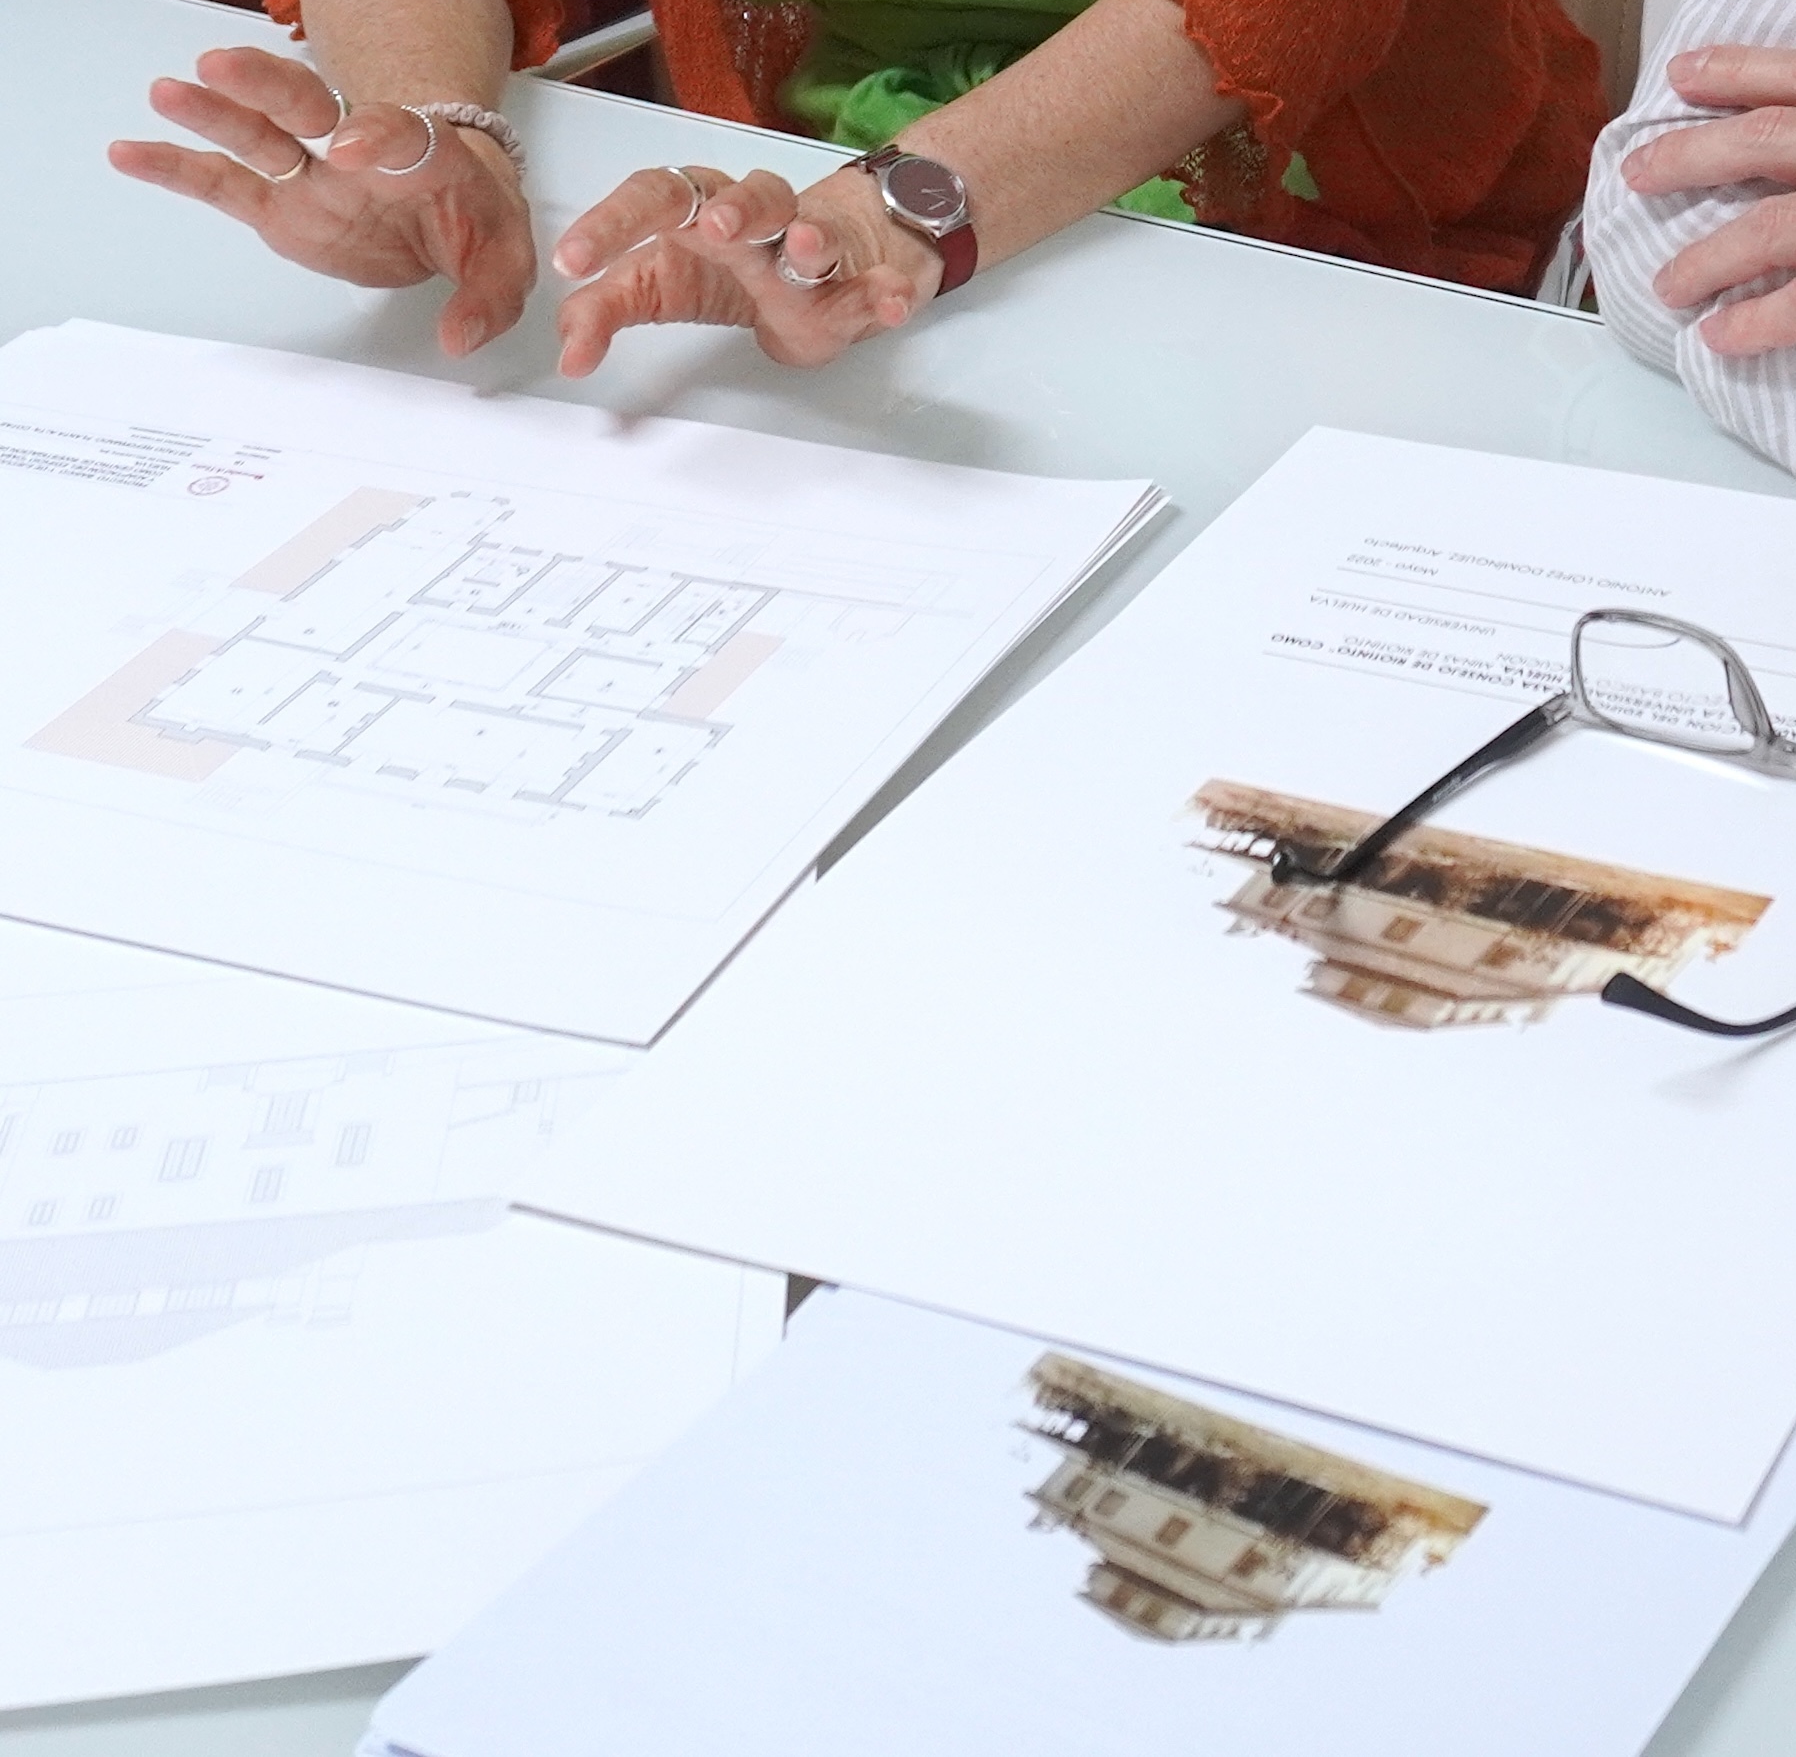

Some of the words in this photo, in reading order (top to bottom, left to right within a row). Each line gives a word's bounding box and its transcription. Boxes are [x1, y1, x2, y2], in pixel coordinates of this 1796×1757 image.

[1395, 562, 1440, 578] Mayo
[1311, 594, 1370, 612] HUELVA
[1373, 607, 1392, 619] DE
[1395, 612, 1498, 638] UNIVERSIDAD
[1270, 633, 1325, 650] COMO
[1417, 650, 1440, 661] DE
[1411, 660, 1434, 672] DE
[1437, 665, 1515, 687] CONSEJO
